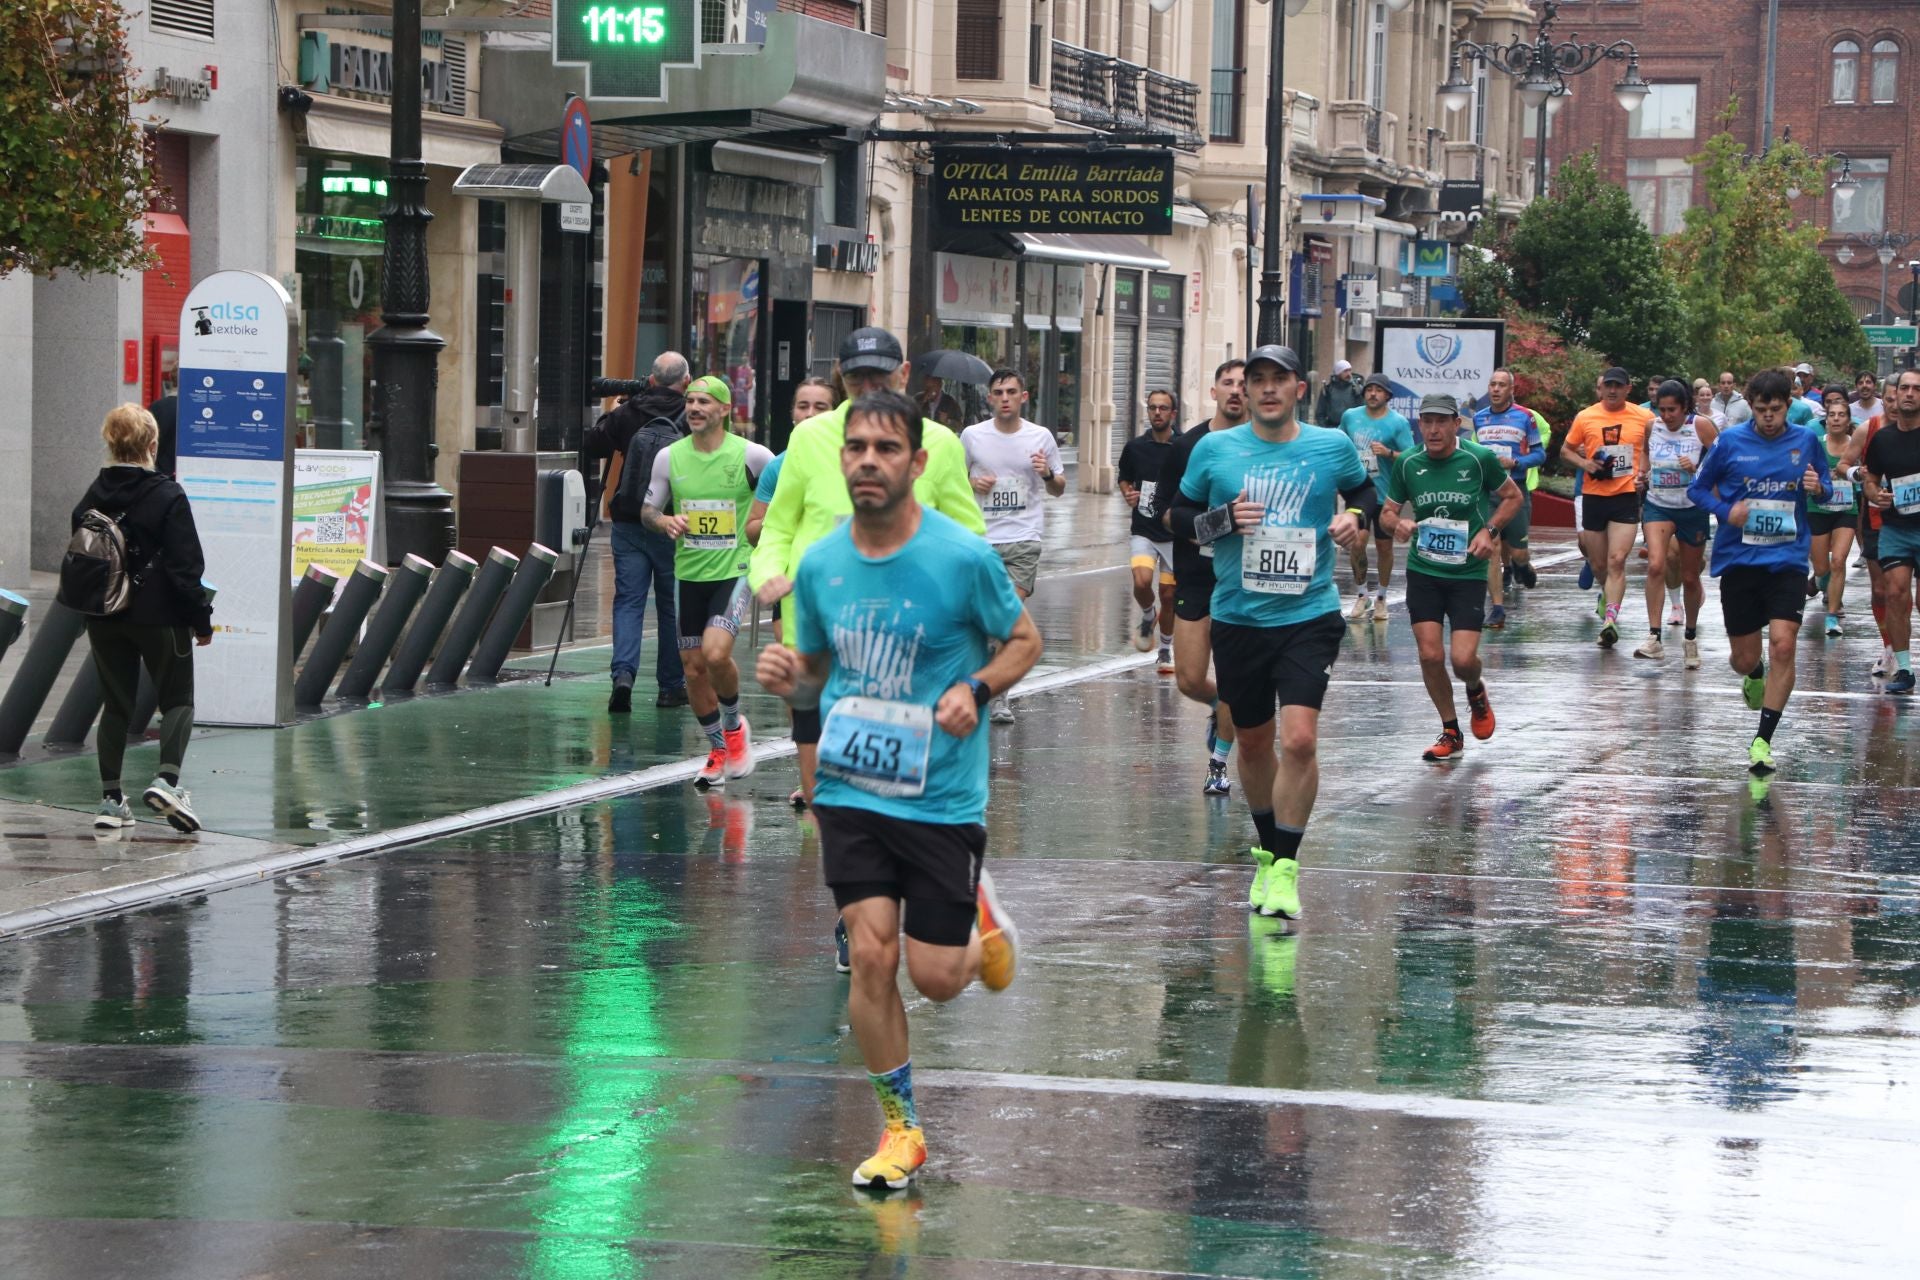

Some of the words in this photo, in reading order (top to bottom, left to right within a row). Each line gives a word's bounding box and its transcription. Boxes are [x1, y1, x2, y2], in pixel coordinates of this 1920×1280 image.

[583, 6, 665, 43] 11:15
[942, 162, 1009, 181] OPTICA
[1018, 164, 1078, 182] Emilia
[1086, 165, 1165, 183] Barriada
[947, 187, 1034, 202] APARATOS
[1040, 188, 1084, 203] PARA
[1091, 189, 1160, 204] SORDOS
[562, 216, 572, 225] CARGA
[575, 217, 590, 226] DESCARGA
[961, 208, 1022, 223] LENTES
[1029, 210, 1051, 224] DE
[1058, 210, 1145, 225] CONTACTO
[846, 243, 858, 271] LA
[859, 243, 881, 273] MAR
[210, 302, 260, 321] alsa
[1396, 367, 1434, 379] VANS
[1433, 371, 1441, 380] &
[1442, 367, 1481, 381] CARS
[1746, 477, 1801, 497] Cajasol
[993, 491, 1018, 507] 890
[1437, 491, 1472, 505] CORRE
[698, 516, 718, 535] 52
[1755, 515, 1783, 533] 562
[335, 546, 365, 554] Abierta
[1428, 532, 1456, 551] 286
[1260, 549, 1299, 575] 804
[1268, 582, 1303, 590] HYUNDAI
[841, 730, 902, 772] 453
